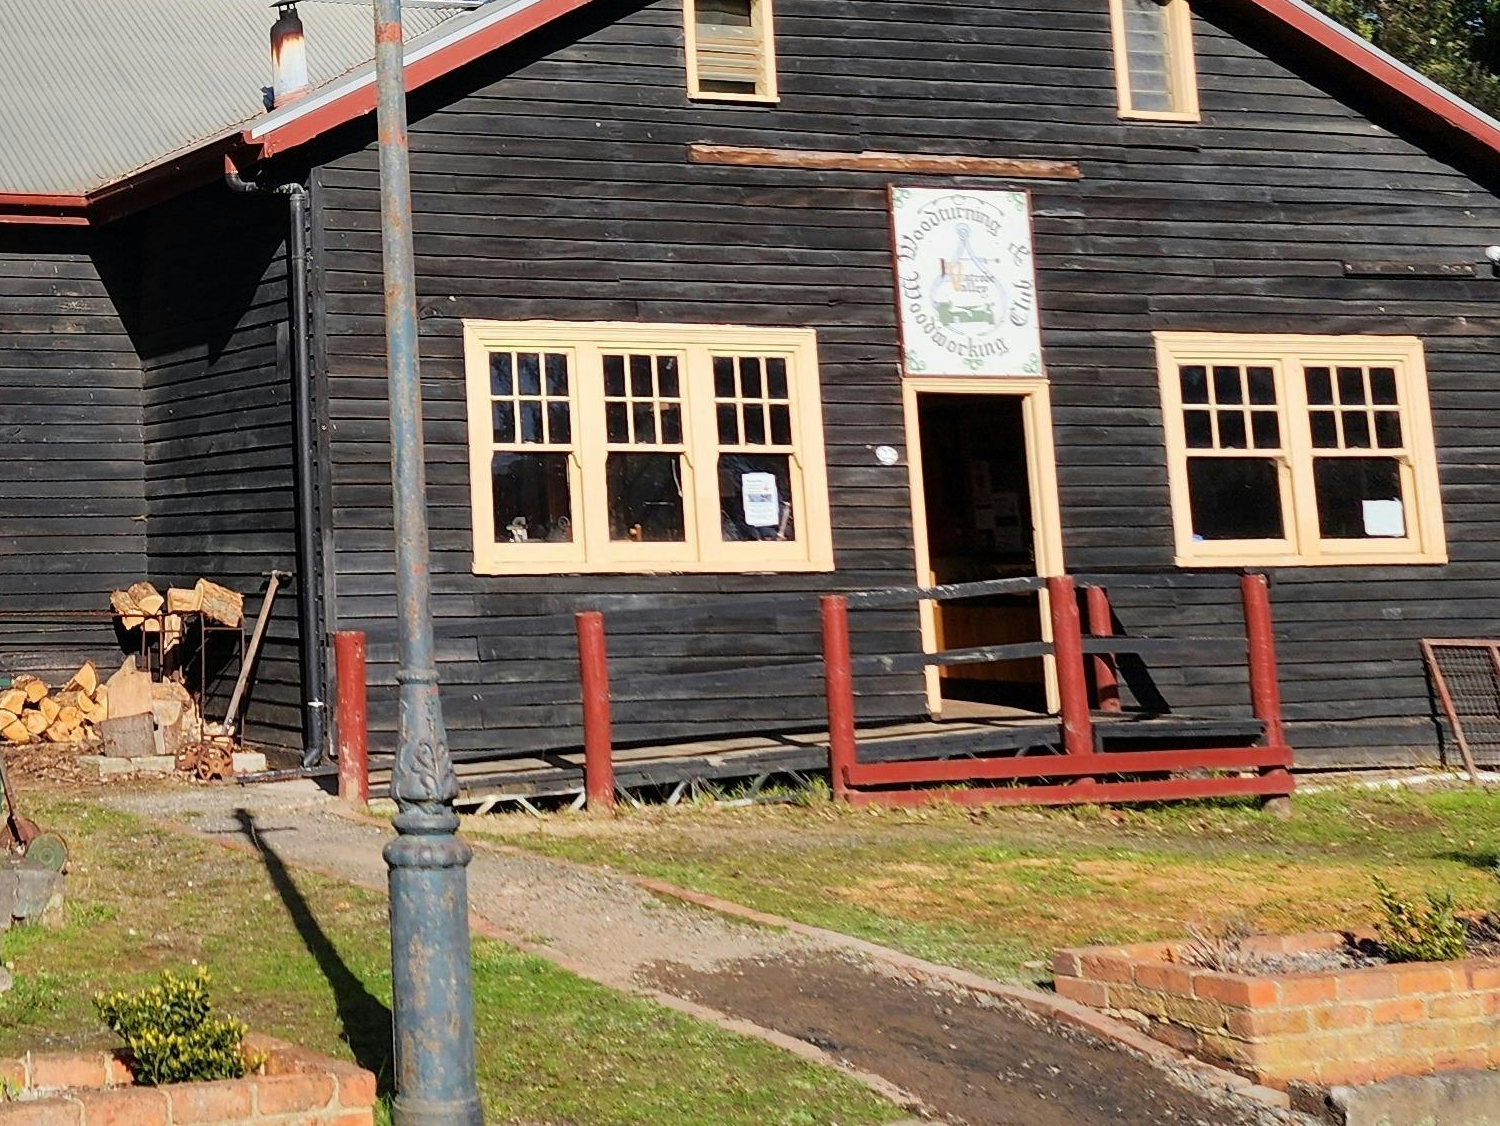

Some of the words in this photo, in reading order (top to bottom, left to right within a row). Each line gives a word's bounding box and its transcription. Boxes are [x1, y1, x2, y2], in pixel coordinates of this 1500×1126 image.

[897, 207, 1002, 262] Woodturning
[900, 270, 1010, 358] Woodworking
[1010, 279, 1032, 326] Club
